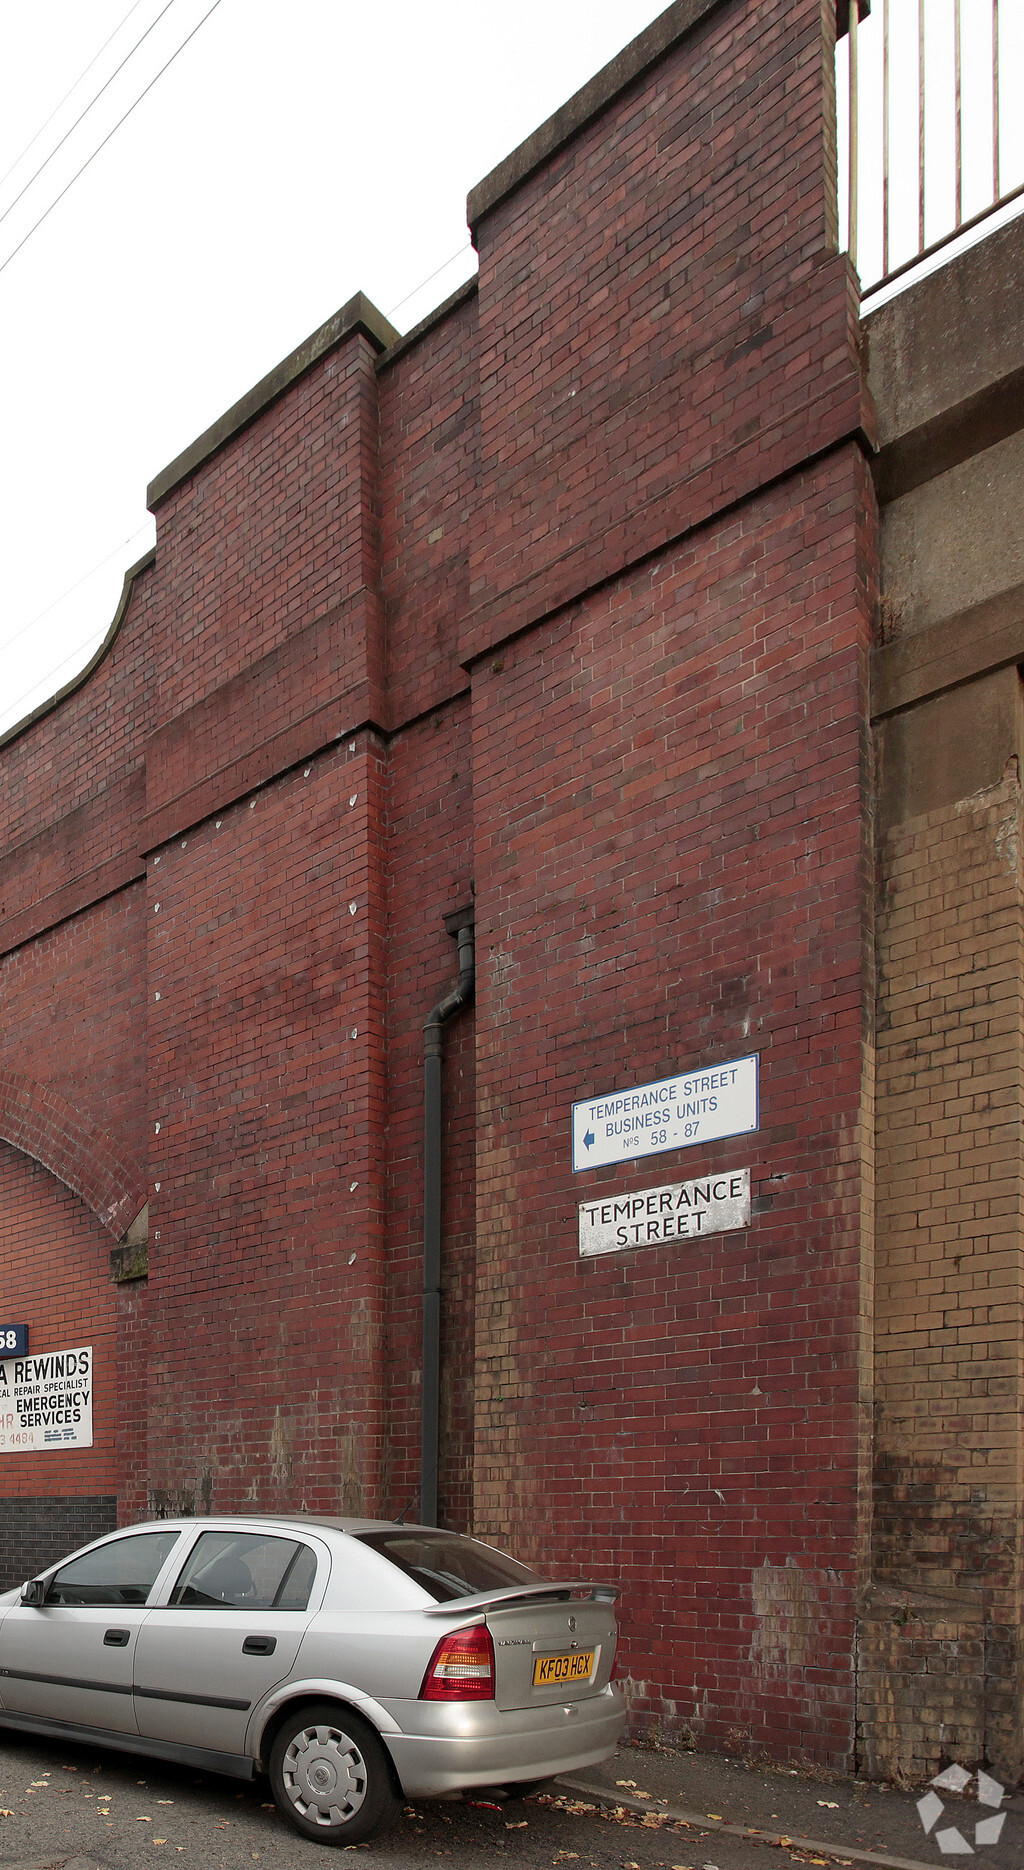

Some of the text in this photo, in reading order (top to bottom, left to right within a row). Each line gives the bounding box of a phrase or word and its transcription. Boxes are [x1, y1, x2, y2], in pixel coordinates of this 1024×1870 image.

[589, 1068, 738, 1121] TEMPERANCE STREET
[605, 1096, 718, 1137] BUSINESS UNITS
[650, 1129, 667, 1146] 58
[684, 1121, 700, 1137] 87
[586, 1176, 743, 1227] TEMPERANCE
[616, 1210, 707, 1246] STREET
[14, 1351, 89, 1384] REWINDS
[13, 1384, 40, 1397] REPAIR
[43, 1378, 88, 1393] SPECIALIST
[16, 1391, 90, 1413] EMERGENCY
[20, 1408, 81, 1428] SERVICES
[539, 1658, 569, 1680] KF03
